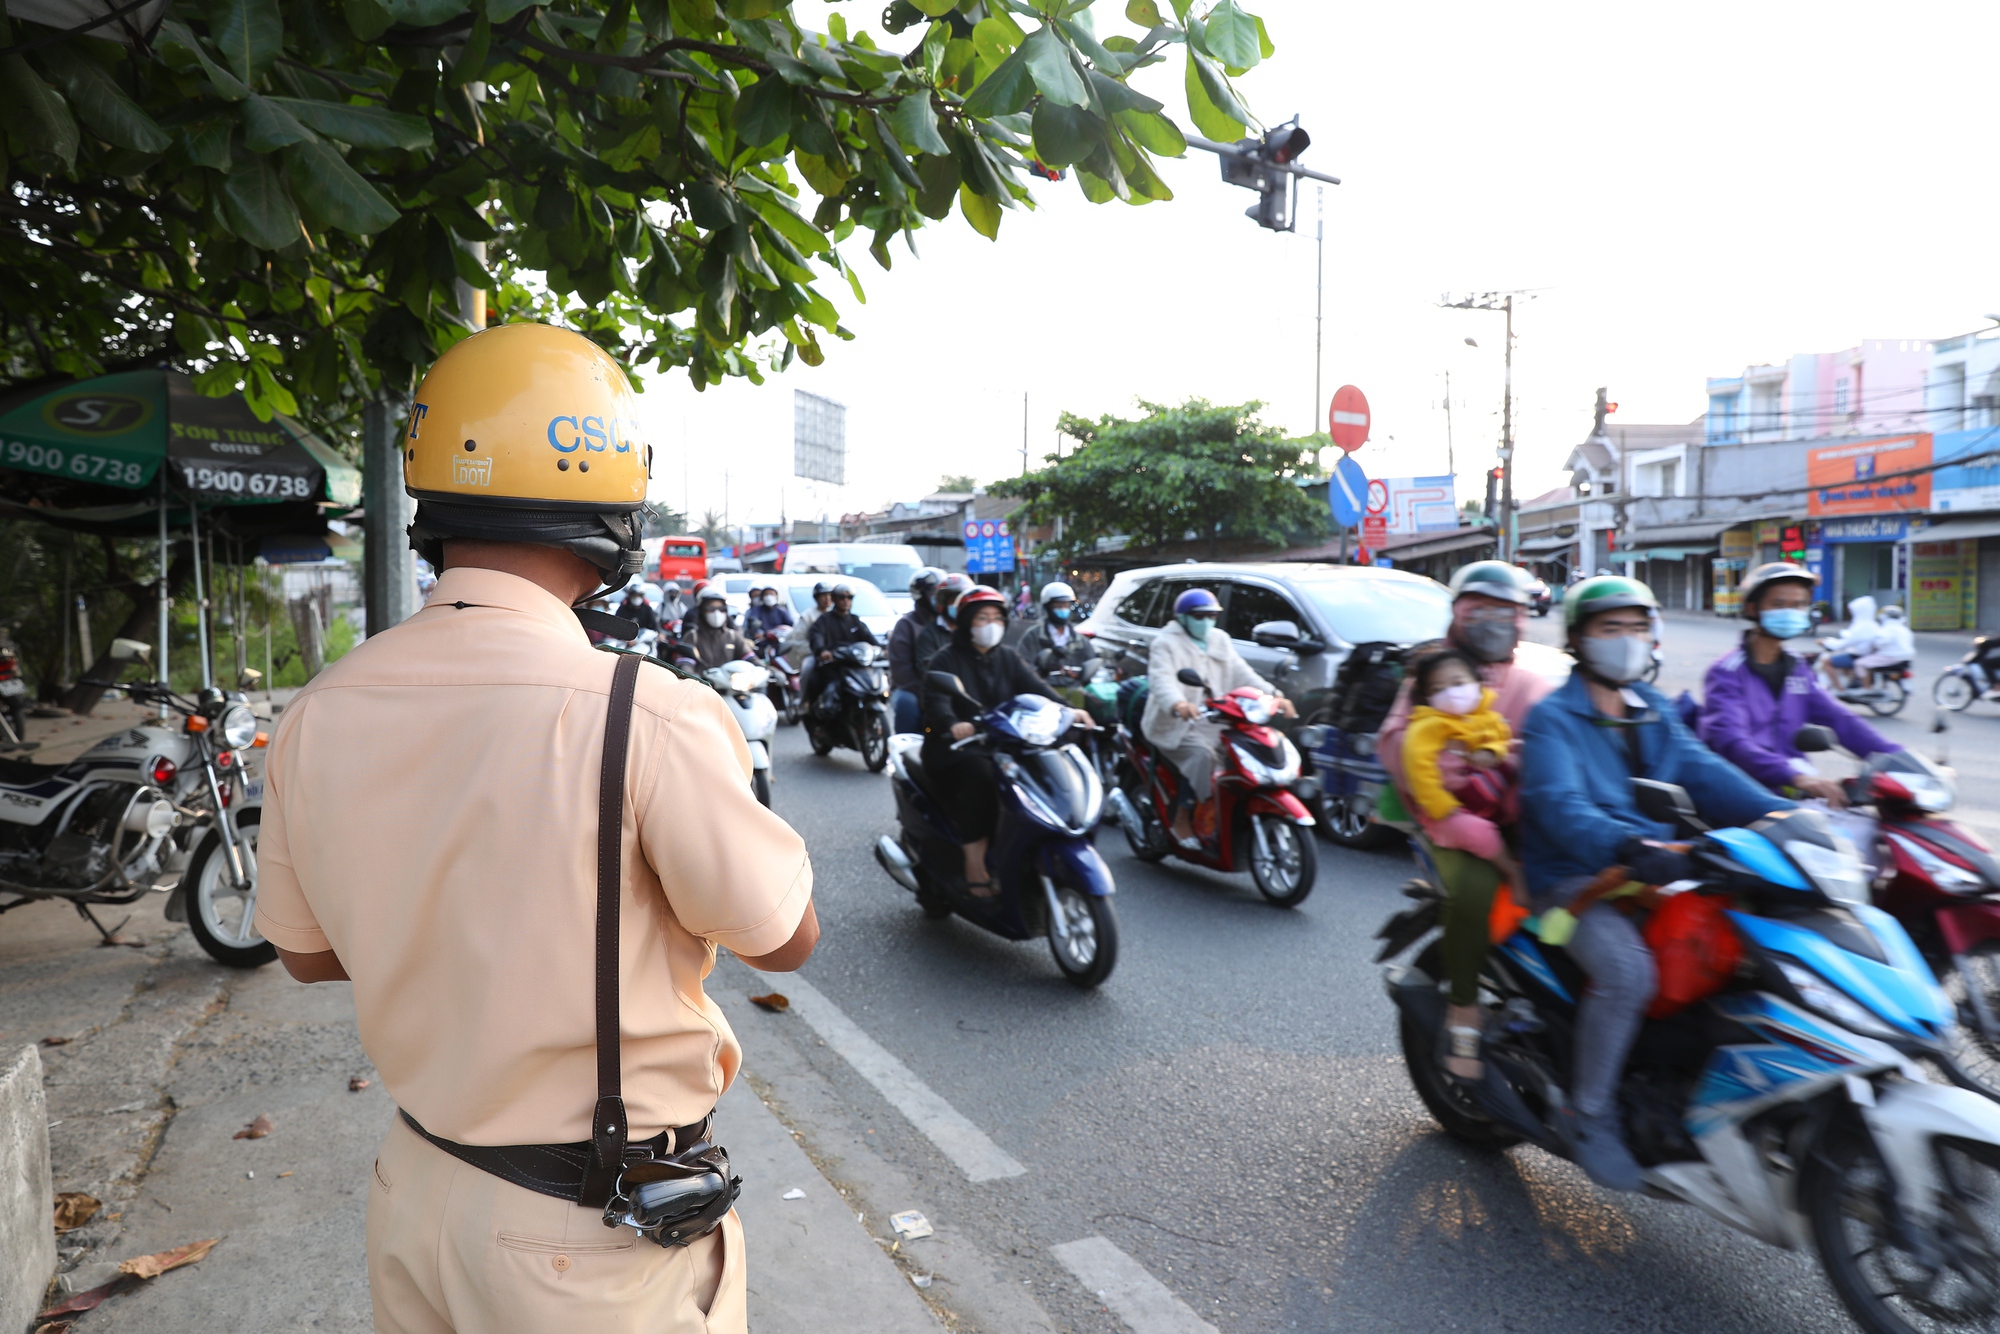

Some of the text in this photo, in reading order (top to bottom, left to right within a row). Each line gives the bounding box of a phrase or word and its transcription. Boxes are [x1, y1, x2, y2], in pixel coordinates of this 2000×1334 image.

[210, 442, 262, 455] COFFEE
[70, 453, 142, 485] 6738
[460, 466, 486, 486] DOT
[183, 466, 310, 497] 1900 6738
[3, 792, 42, 807] POLICE
